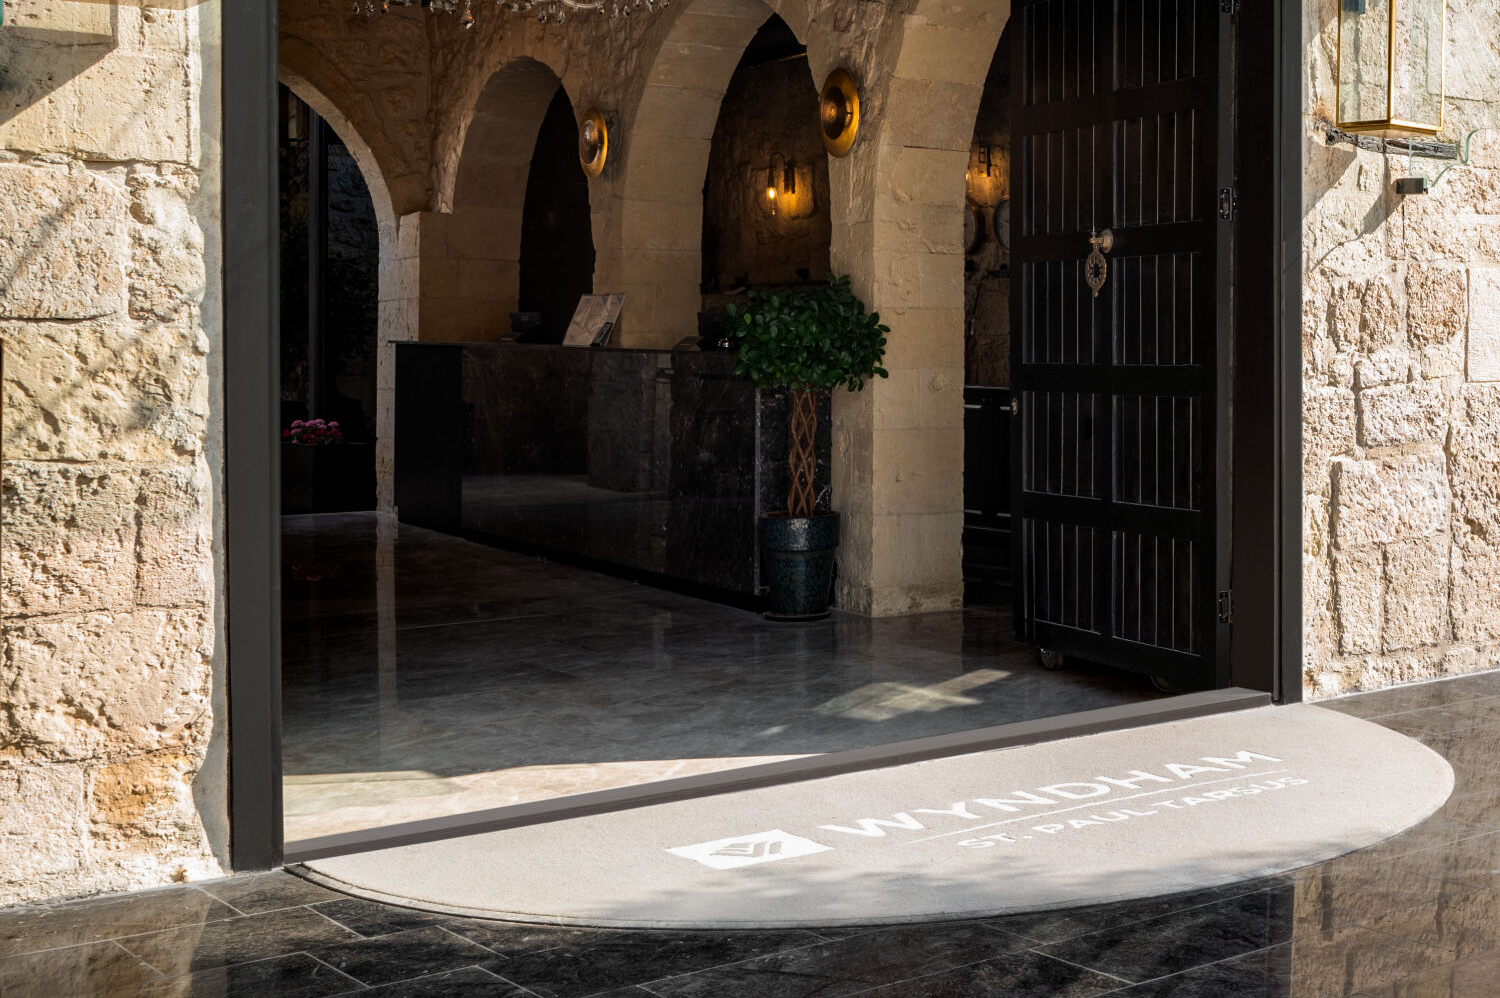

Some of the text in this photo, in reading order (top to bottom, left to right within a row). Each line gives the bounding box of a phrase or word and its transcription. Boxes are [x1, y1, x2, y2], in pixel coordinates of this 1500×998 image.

[818, 750, 1284, 838] WYNDHAM
[957, 776, 1310, 849] ST. PAUL TARSUS
